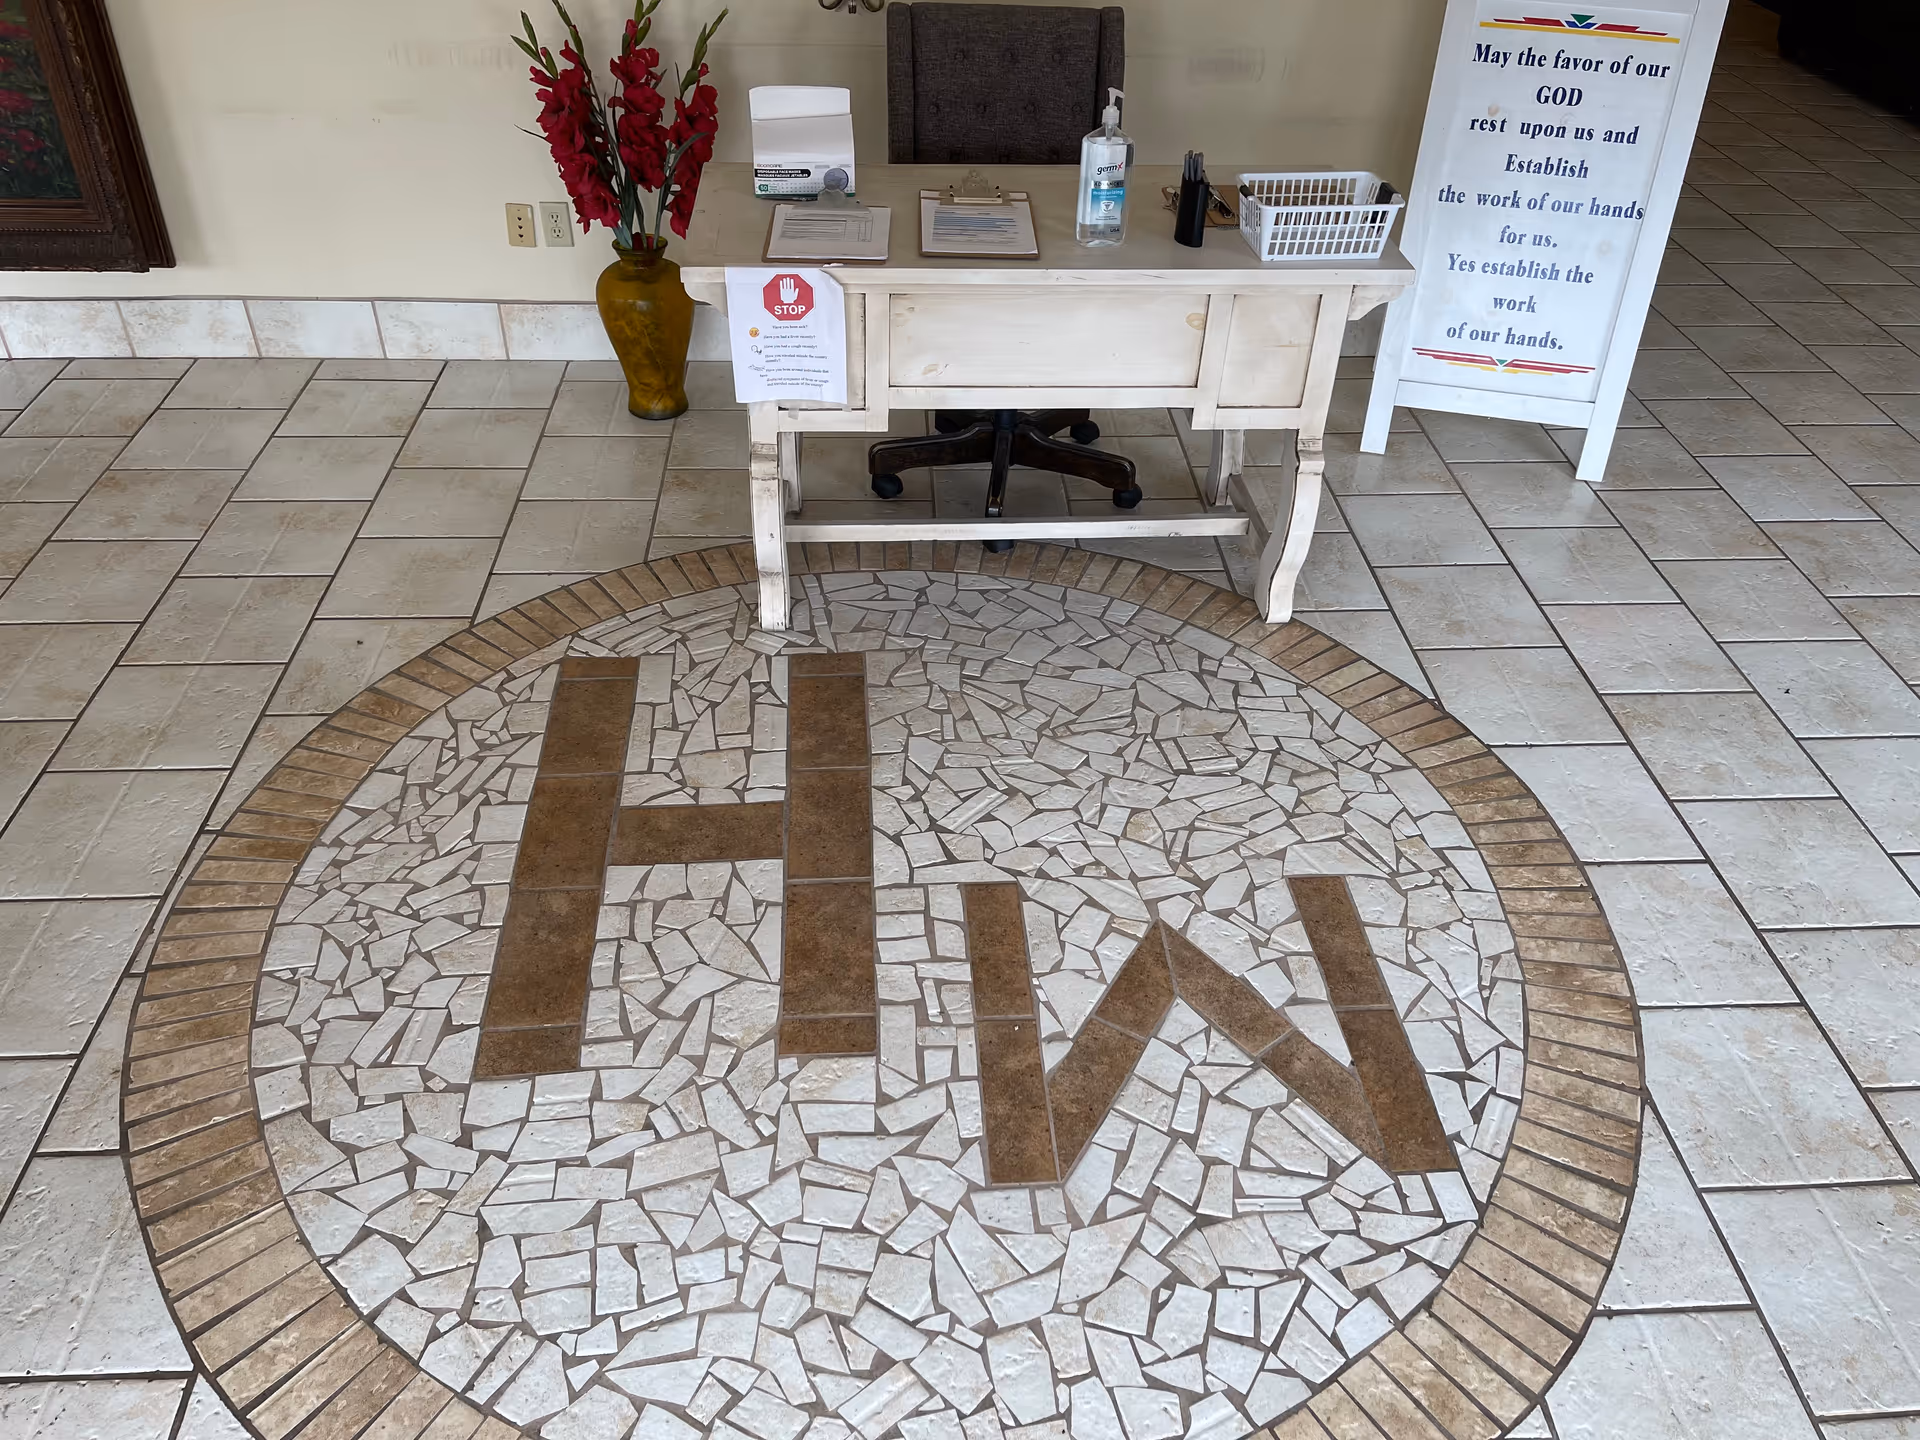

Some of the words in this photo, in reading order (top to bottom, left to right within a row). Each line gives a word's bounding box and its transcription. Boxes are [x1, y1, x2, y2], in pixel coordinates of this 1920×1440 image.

[1472, 43, 1512, 68] May
[1517, 47, 1547, 67] the
[1552, 49, 1603, 73] favor
[1609, 55, 1634, 75] of
[1635, 62, 1670, 78] our
[1536, 85, 1583, 107] GOD
[1469, 116, 1508, 133] rest
[1519, 121, 1567, 140] upon
[1574, 126, 1594, 141] us
[1602, 126, 1640, 145] and
[1504, 153, 1589, 179] Establish
[1438, 184, 1466, 204] the
[1476, 190, 1521, 209] work
[1526, 192, 1550, 211] of
[1551, 200, 1584, 215] our
[1588, 196, 1645, 220] hands
[1498, 225, 1527, 245] for
[1532, 233, 1558, 248] us.
[1447, 252, 1476, 272] Yes
[1481, 256, 1560, 281] establish
[1565, 263, 1594, 284] the
[774, 305, 806, 315] STOP
[1493, 295, 1537, 314] work
[1446, 322, 1467, 339] of
[1469, 328, 1500, 343] our
[1504, 327, 1563, 351] hands.
